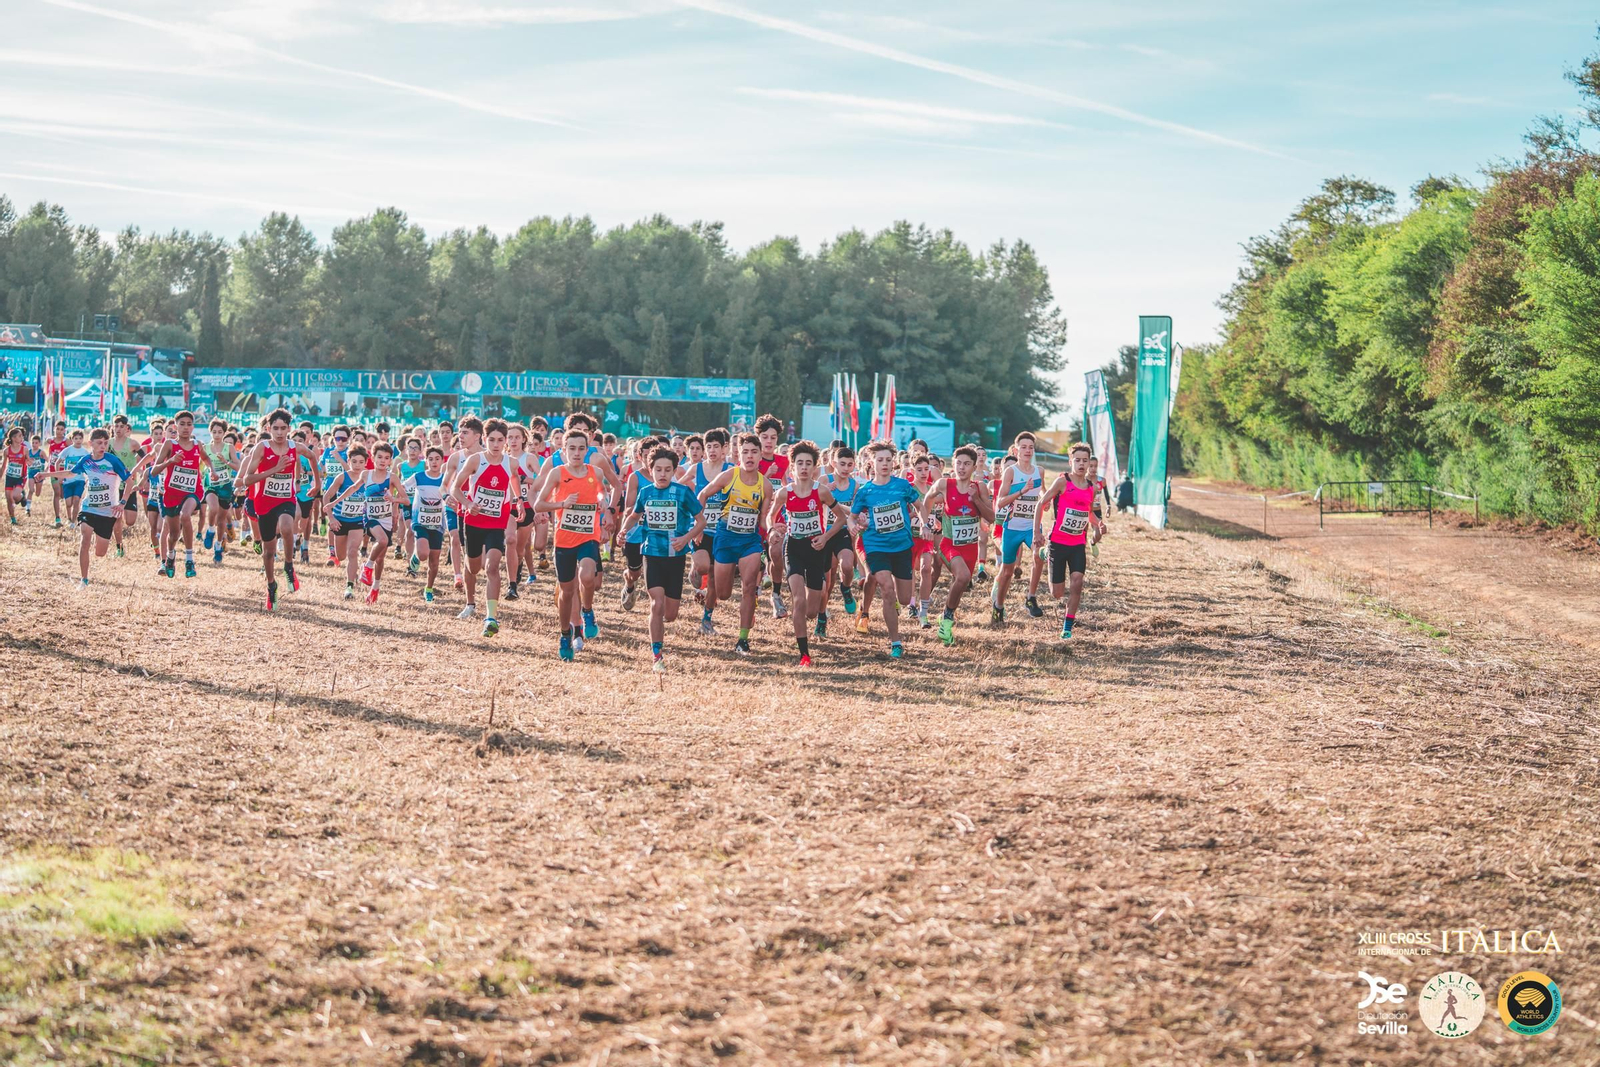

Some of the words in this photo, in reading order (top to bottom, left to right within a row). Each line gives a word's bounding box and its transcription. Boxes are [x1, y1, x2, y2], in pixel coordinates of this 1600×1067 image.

[268, 372, 309, 387] XLIII
[310, 372, 344, 382] CROSS
[494, 376, 534, 391] XLIII
[536, 376, 569, 387] CROSS
[173, 475, 196, 486] 8010
[267, 481, 290, 491] 8012
[89, 493, 110, 503] 5938
[476, 496, 500, 510] 7953
[370, 504, 390, 513] 8017
[564, 513, 593, 526] 5882
[648, 511, 675, 522] 5833
[731, 516, 755, 527] 5813
[876, 513, 902, 526] 5904
[793, 521, 819, 532] 7948
[1065, 519, 1086, 528] 5819
[955, 527, 978, 538] 7974
